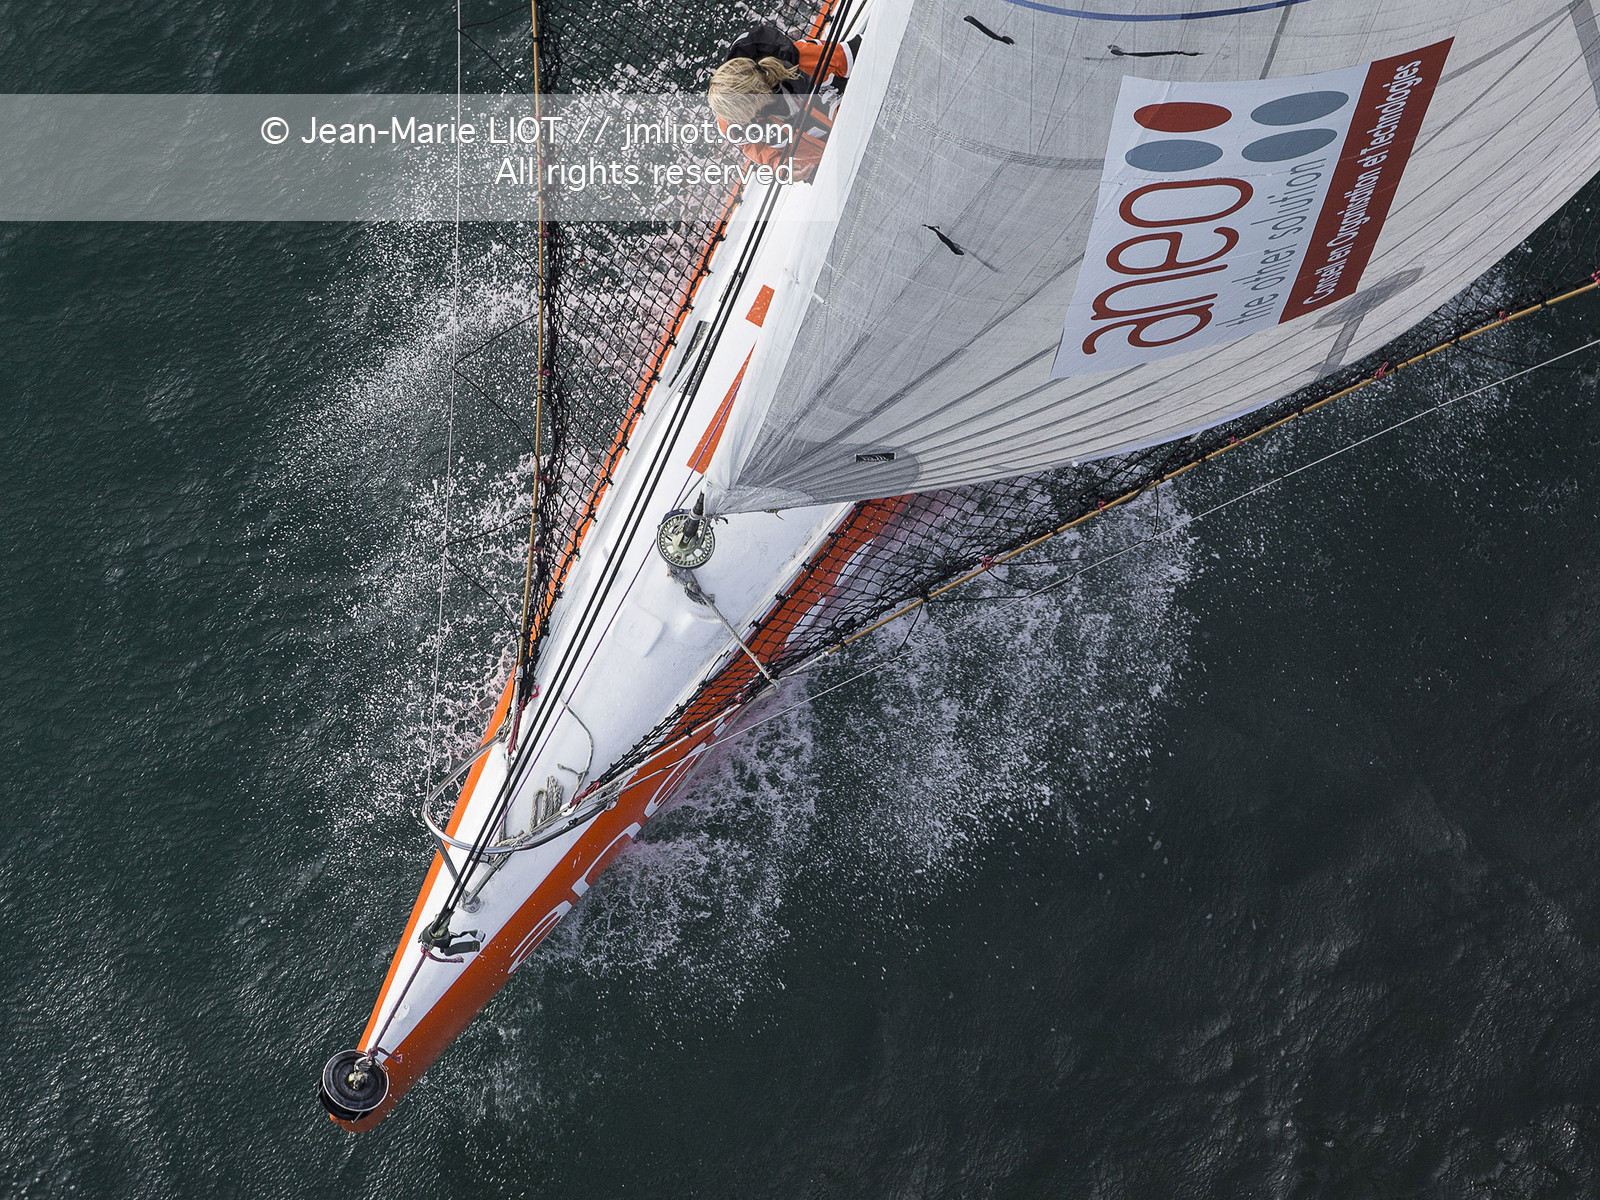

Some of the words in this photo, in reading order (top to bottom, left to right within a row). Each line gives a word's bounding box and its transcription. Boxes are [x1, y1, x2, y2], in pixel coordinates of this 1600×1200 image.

[1359, 60, 1423, 156] Technologies
[1356, 149, 1389, 168] et
[1250, 158, 1328, 241] solution
[1326, 166, 1384, 247] Organisation
[1081, 177, 1255, 355] aneo
[1231, 242, 1298, 291] other
[1302, 258, 1348, 305] Conseil
[1215, 293, 1280, 328] the
